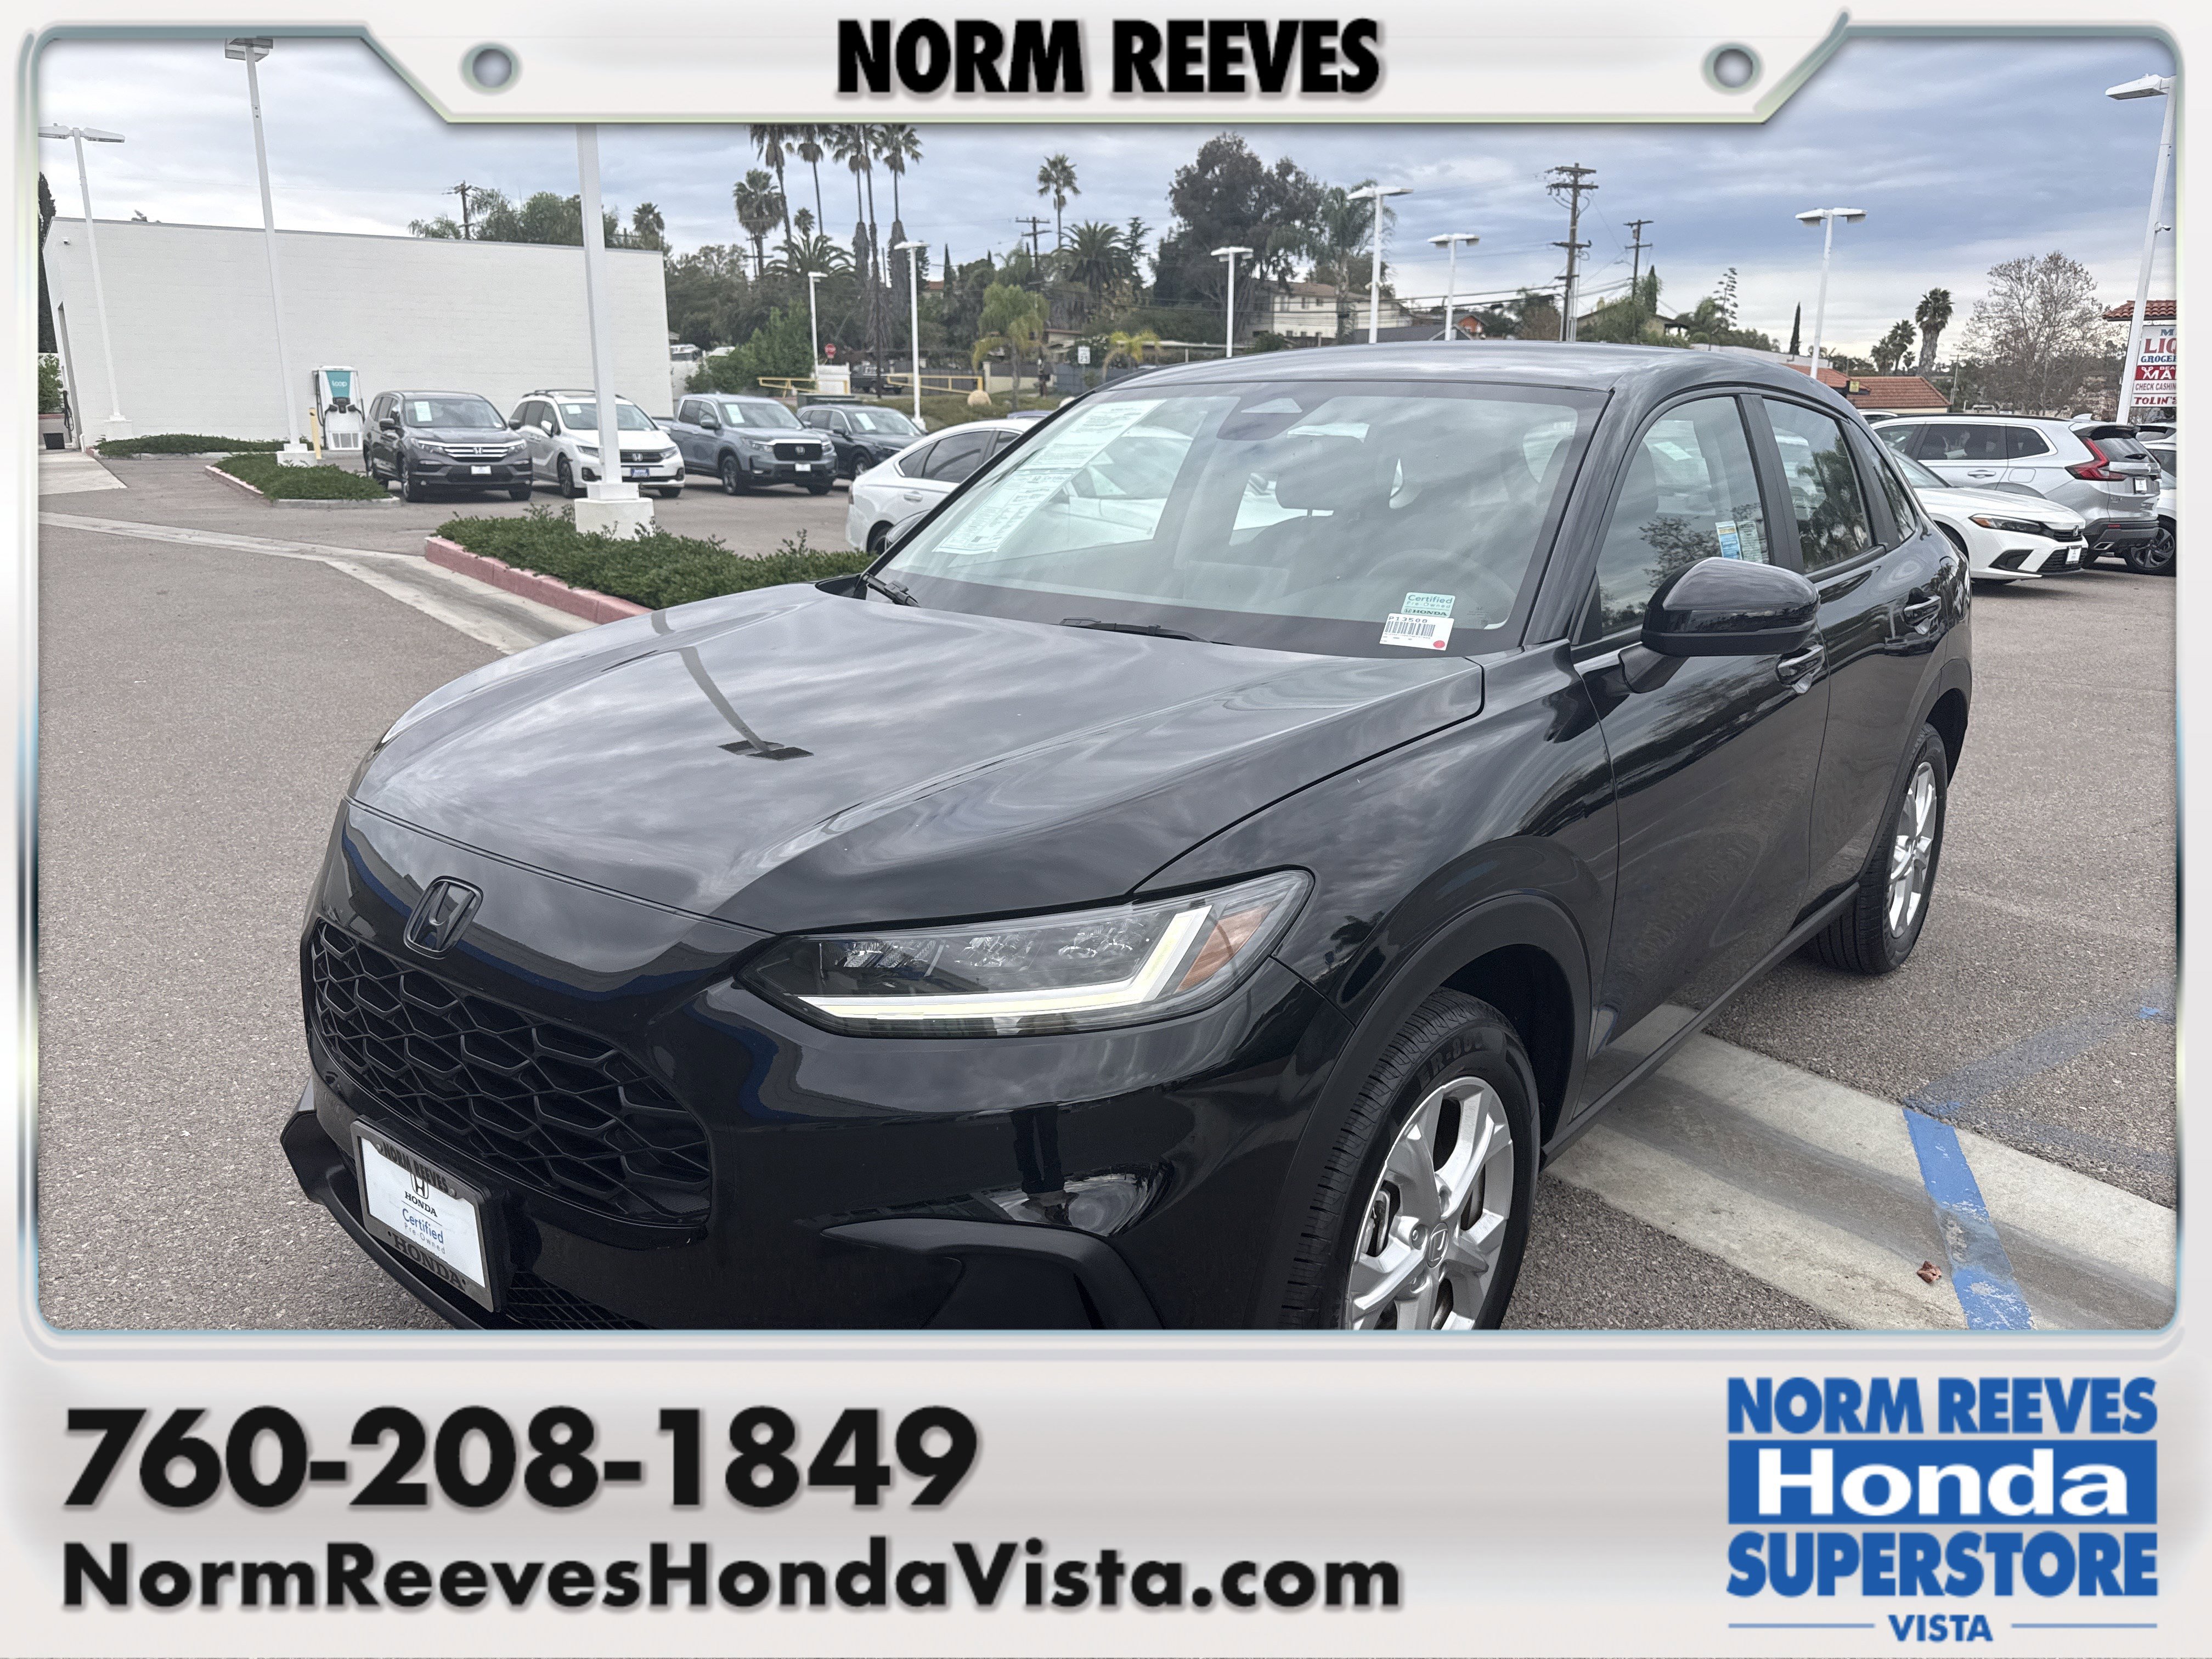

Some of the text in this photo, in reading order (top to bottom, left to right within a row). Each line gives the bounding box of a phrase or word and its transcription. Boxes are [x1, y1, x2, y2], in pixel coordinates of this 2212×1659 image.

[2142, 369, 2176, 380] MA
[1408, 595, 1453, 604] Certified
[382, 1141, 449, 1193] NORM REEVES
[404, 1191, 438, 1218] HONDA
[402, 1208, 444, 1244] Certified
[392, 1233, 466, 1292] HONDA
